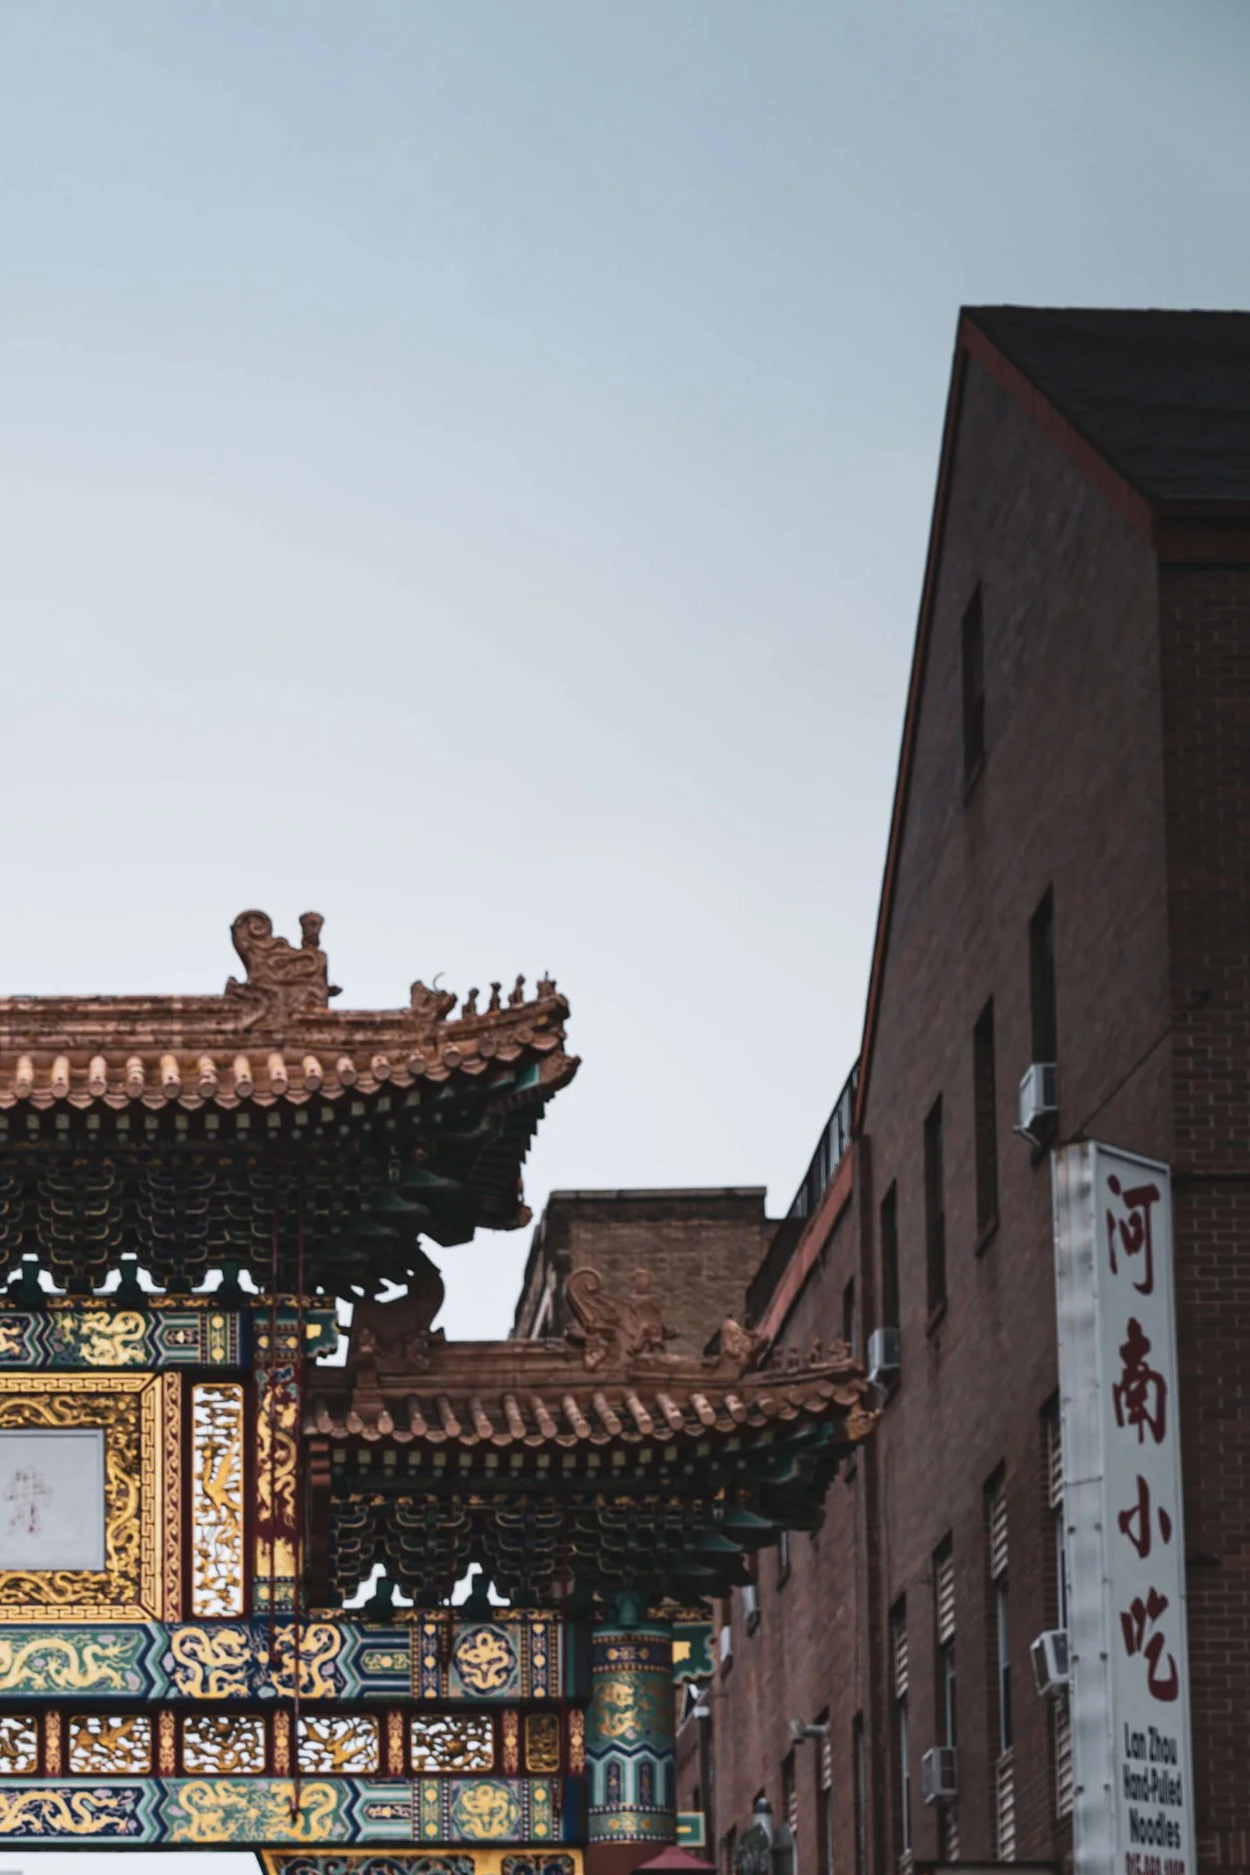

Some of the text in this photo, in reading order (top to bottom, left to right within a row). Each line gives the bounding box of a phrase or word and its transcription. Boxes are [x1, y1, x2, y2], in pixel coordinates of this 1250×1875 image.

[1106, 1172, 1181, 1704] 河南小吃
[1124, 1722, 1178, 1766] Lan Zhou
[1129, 1807, 1182, 1850] Noodles
